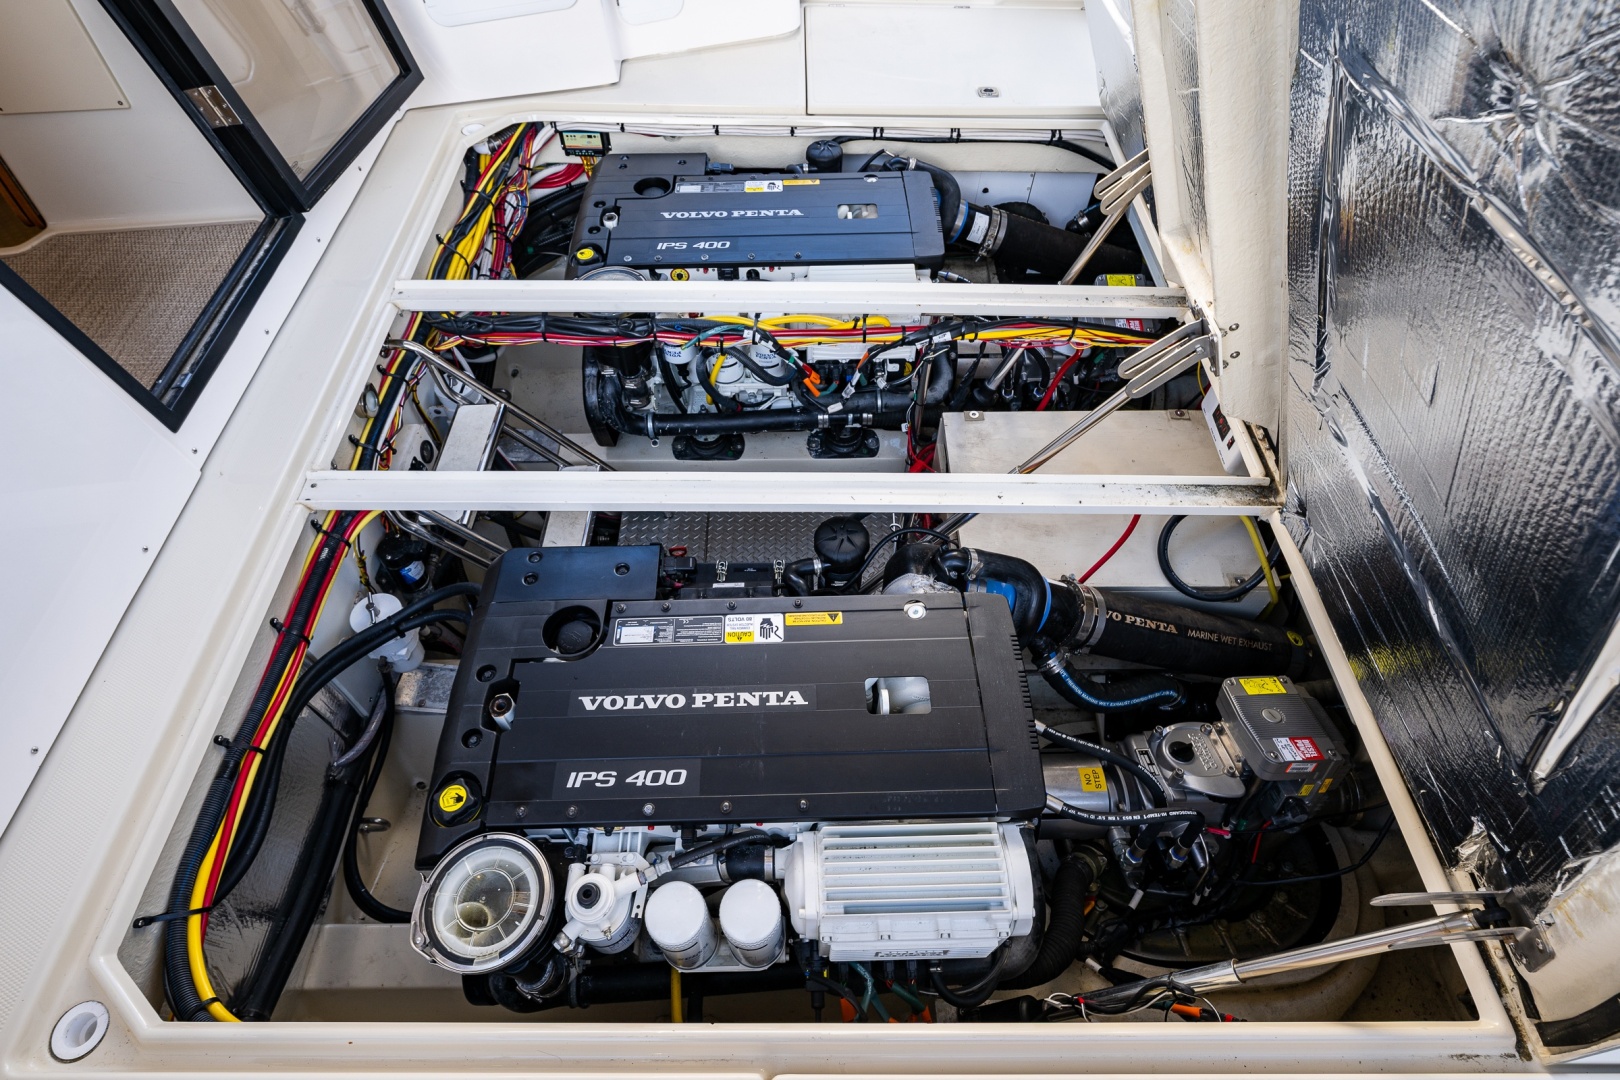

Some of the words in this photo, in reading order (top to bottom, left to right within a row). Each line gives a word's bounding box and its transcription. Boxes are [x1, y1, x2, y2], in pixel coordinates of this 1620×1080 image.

[660, 210, 728, 219] VOLVO
[731, 209, 804, 217] PENTA
[656, 242, 688, 250] IPS
[692, 241, 731, 249] 400
[1124, 614, 1178, 634] PENTA
[1187, 628, 1218, 642] MARINE
[1220, 634, 1236, 645] WET
[1239, 637, 1272, 651] EXHAUST
[578, 693, 687, 711] VOLVO
[691, 690, 809, 708] PENTA
[566, 771, 618, 788] IPS
[625, 769, 688, 786] 400
[1084, 773, 1092, 785] NO
[1092, 769, 1102, 789] STEP
